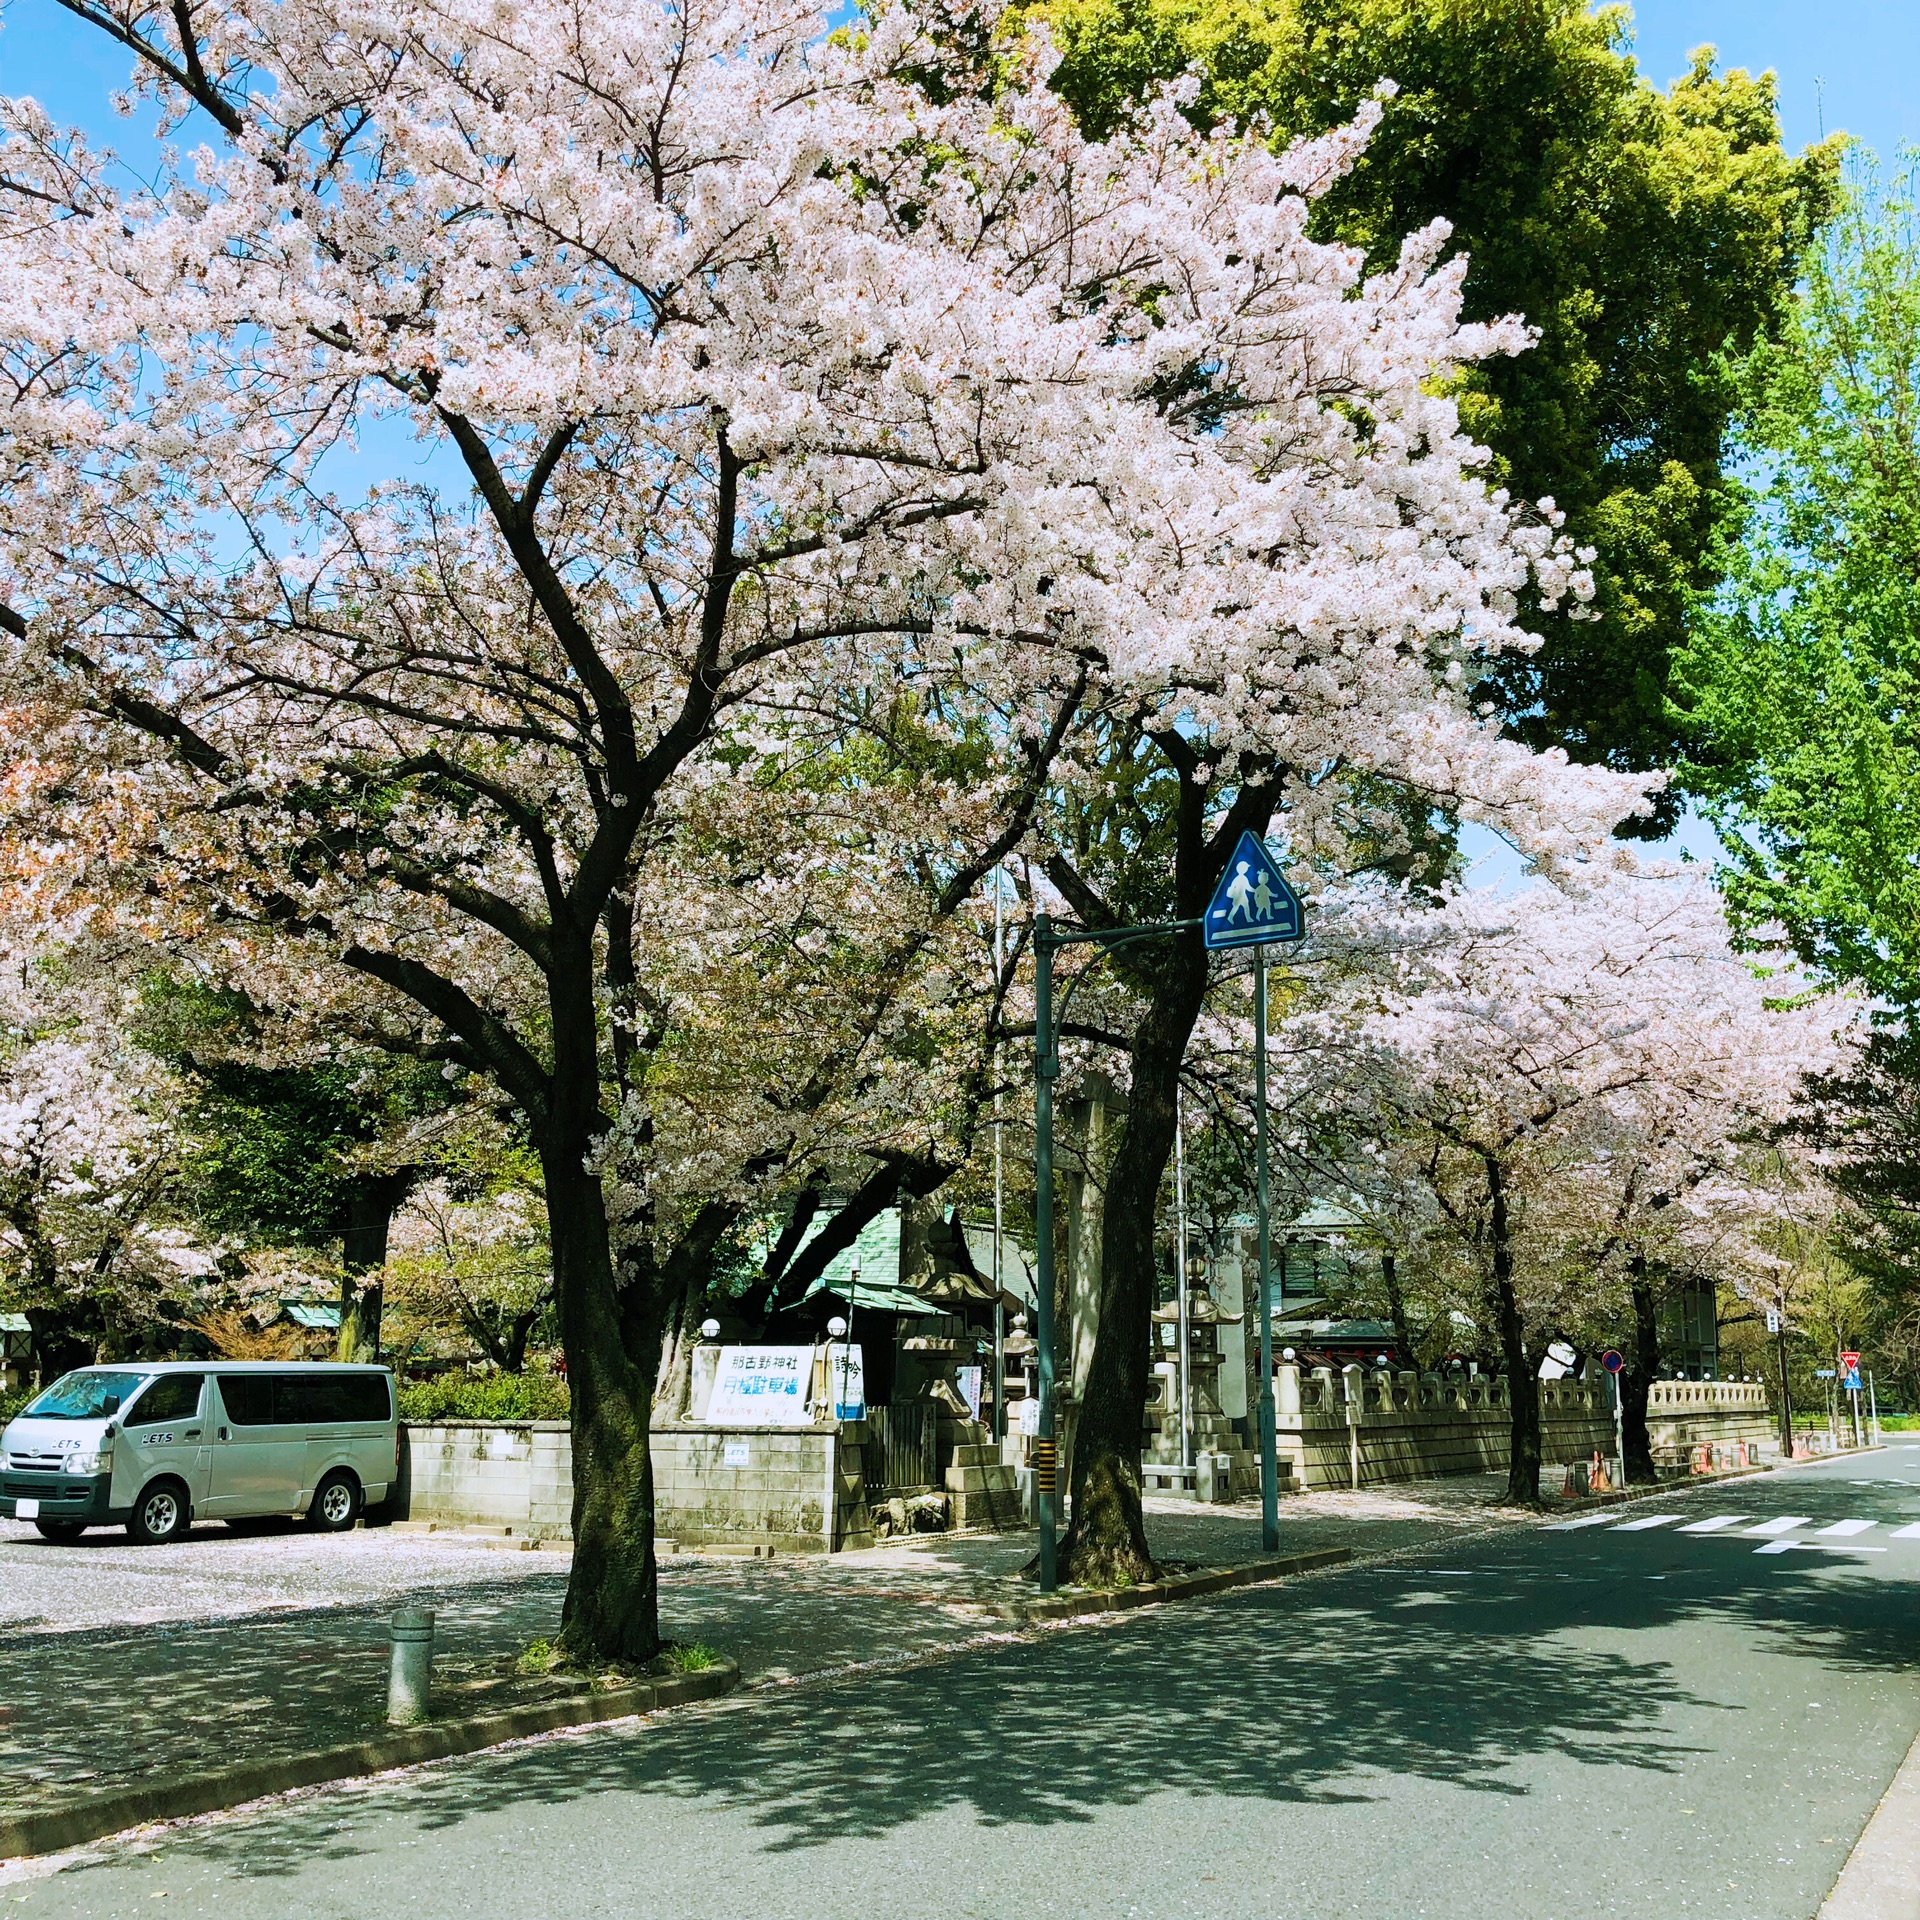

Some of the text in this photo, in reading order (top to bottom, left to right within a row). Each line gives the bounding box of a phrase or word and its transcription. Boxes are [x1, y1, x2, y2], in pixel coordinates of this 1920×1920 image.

[732, 1355, 798, 1370] 那古野神社
[835, 1356, 861, 1379] 詩吟
[722, 1375, 799, 1395] 月極駐車場
[142, 1433, 173, 1444] LETS
